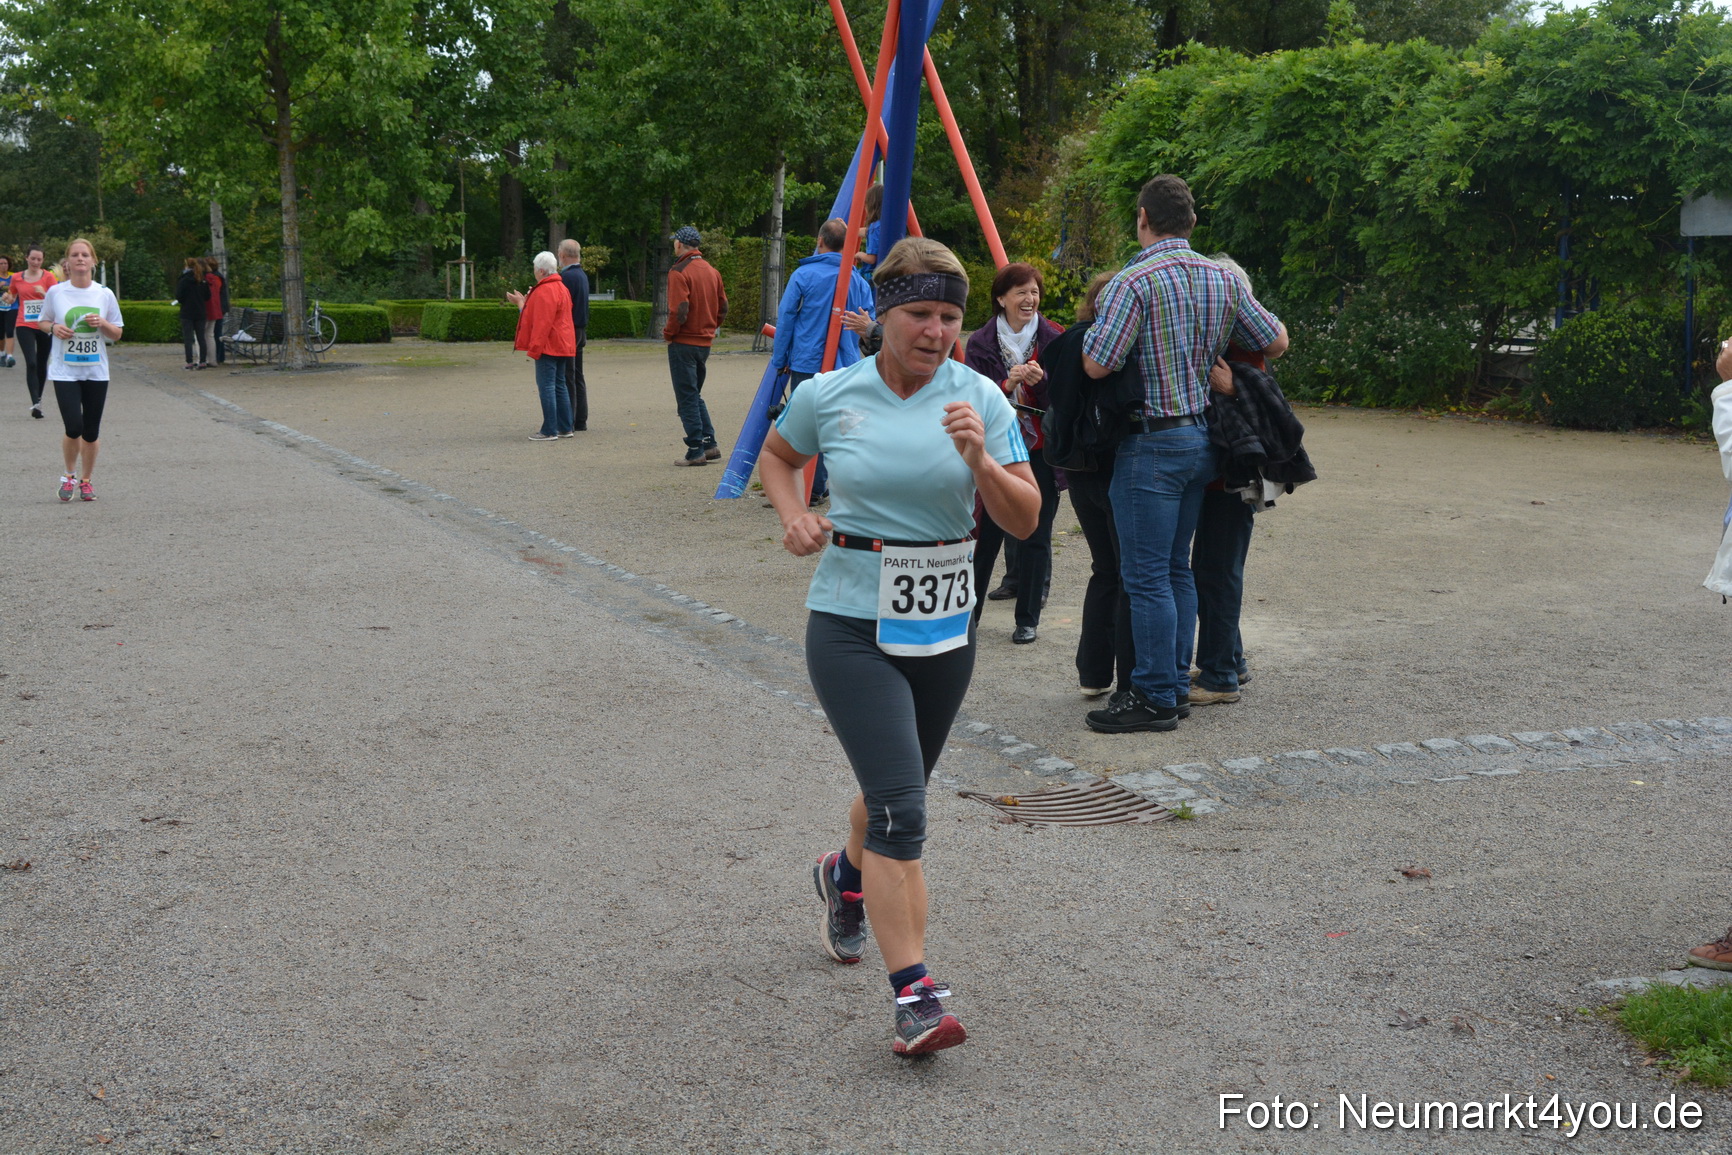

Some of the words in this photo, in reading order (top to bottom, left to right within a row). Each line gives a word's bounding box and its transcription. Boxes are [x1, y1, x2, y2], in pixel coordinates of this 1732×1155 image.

[26, 305, 43, 313] 235
[68, 341, 98, 353] 2488
[884, 558, 924, 569] PARTL
[927, 555, 965, 569] Neumarkt
[892, 569, 969, 614] 3373
